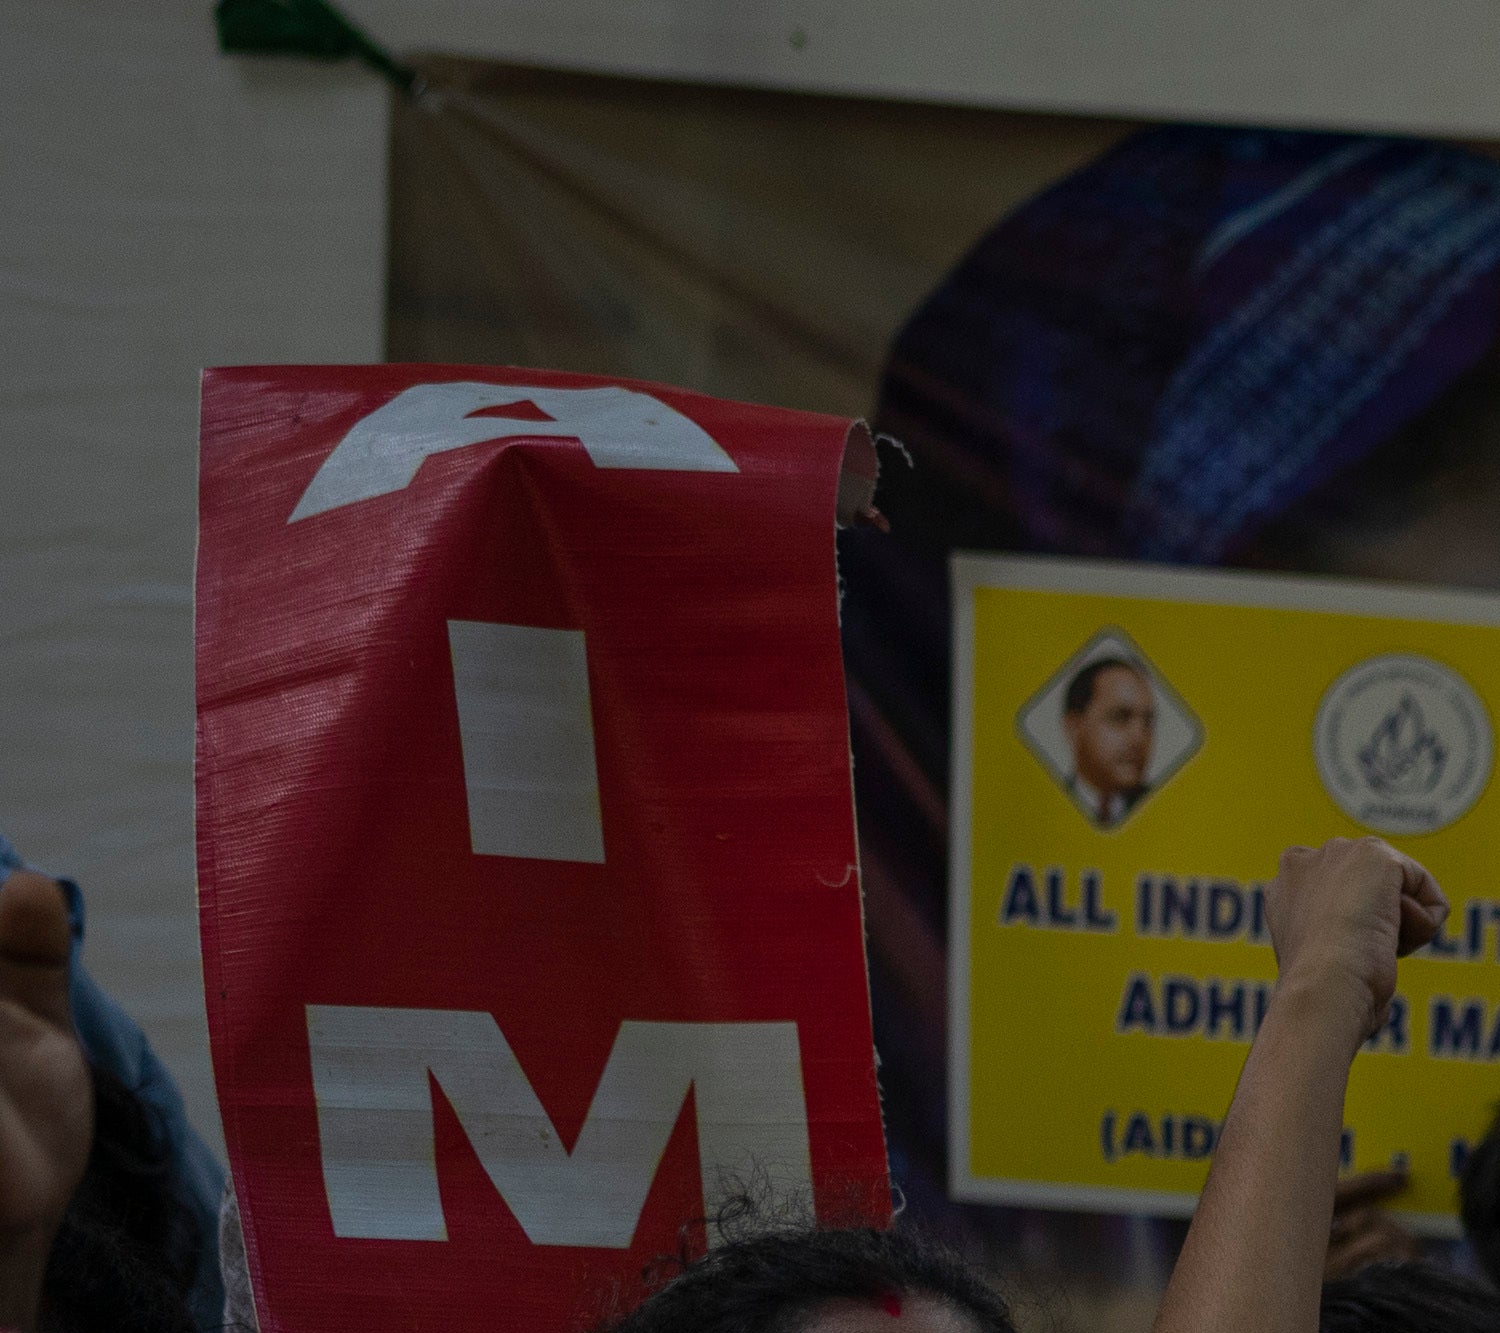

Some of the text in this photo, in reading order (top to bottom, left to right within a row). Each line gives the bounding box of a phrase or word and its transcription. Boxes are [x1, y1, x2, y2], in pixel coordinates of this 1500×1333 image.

[1002, 867, 1116, 930] ALL
[1137, 875, 1267, 940] INDI
[1119, 974, 1408, 1052] ADHIR
